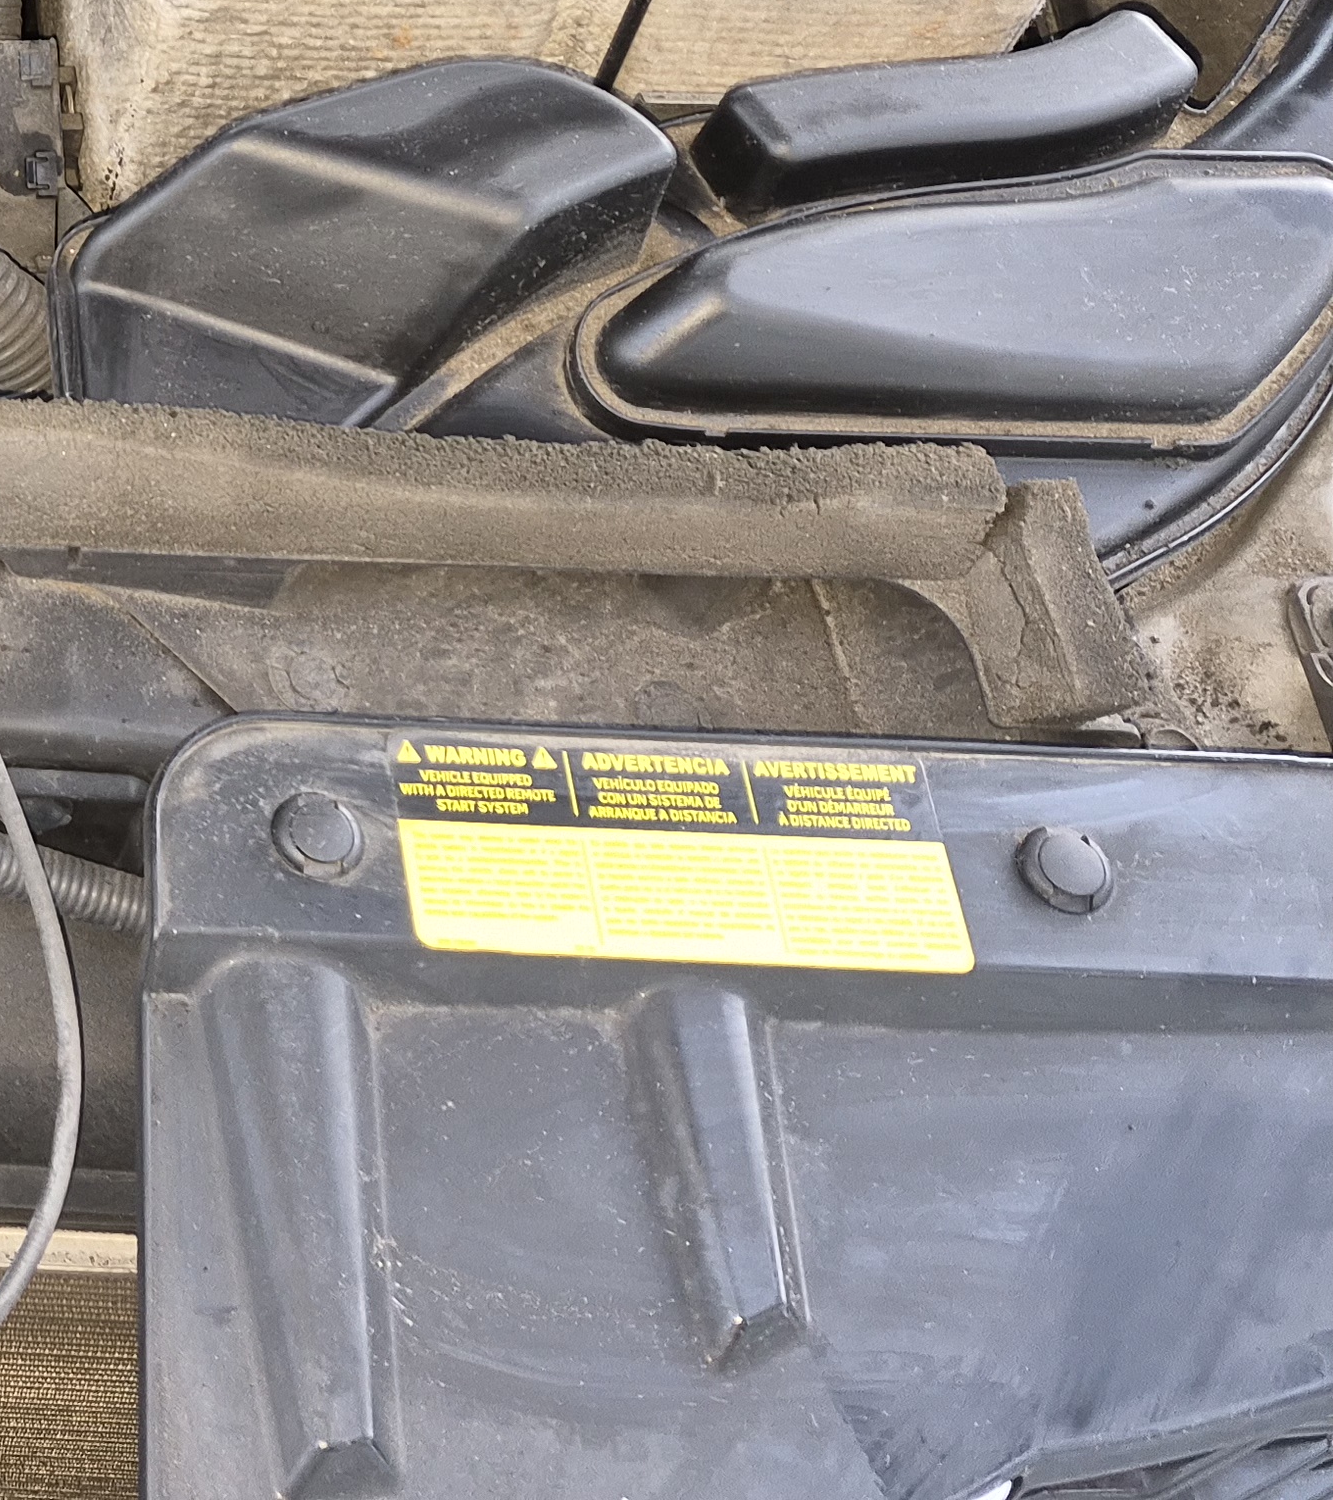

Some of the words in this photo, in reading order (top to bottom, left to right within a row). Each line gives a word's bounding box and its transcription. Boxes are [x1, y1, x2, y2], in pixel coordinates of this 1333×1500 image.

[424, 744, 527, 768] WARNING
[581, 751, 731, 777] ADVERTENCIA
[418, 769, 472, 784] VEHICLE
[471, 771, 533, 788] EQUIPPED
[754, 760, 916, 784] AVERTISSEMENT
[398, 782, 434, 797] WITH
[435, 783, 446, 797] A
[446, 785, 505, 800] DIRECTED
[504, 787, 557, 803] REMOTE
[592, 775, 656, 792] VEHÍCULO
[656, 779, 721, 796] EQUIPADO
[782, 782, 845, 800] VÉHICULE
[435, 799, 476, 813] START
[477, 801, 530, 816] SYSTEM
[597, 791, 626, 805] CON
[627, 793, 648, 807] UN
[648, 794, 704, 809] SISTEMA
[704, 795, 723, 810] DE
[786, 799, 817, 813] D'UN
[818, 799, 895, 817] DÉMARREUR
[588, 805, 657, 822] ARRANQUE
[657, 807, 669, 822] A
[669, 809, 738, 825] DISTANCIA
[789, 814, 850, 830] DISTANCE
[850, 818, 912, 833] DIRECTED
